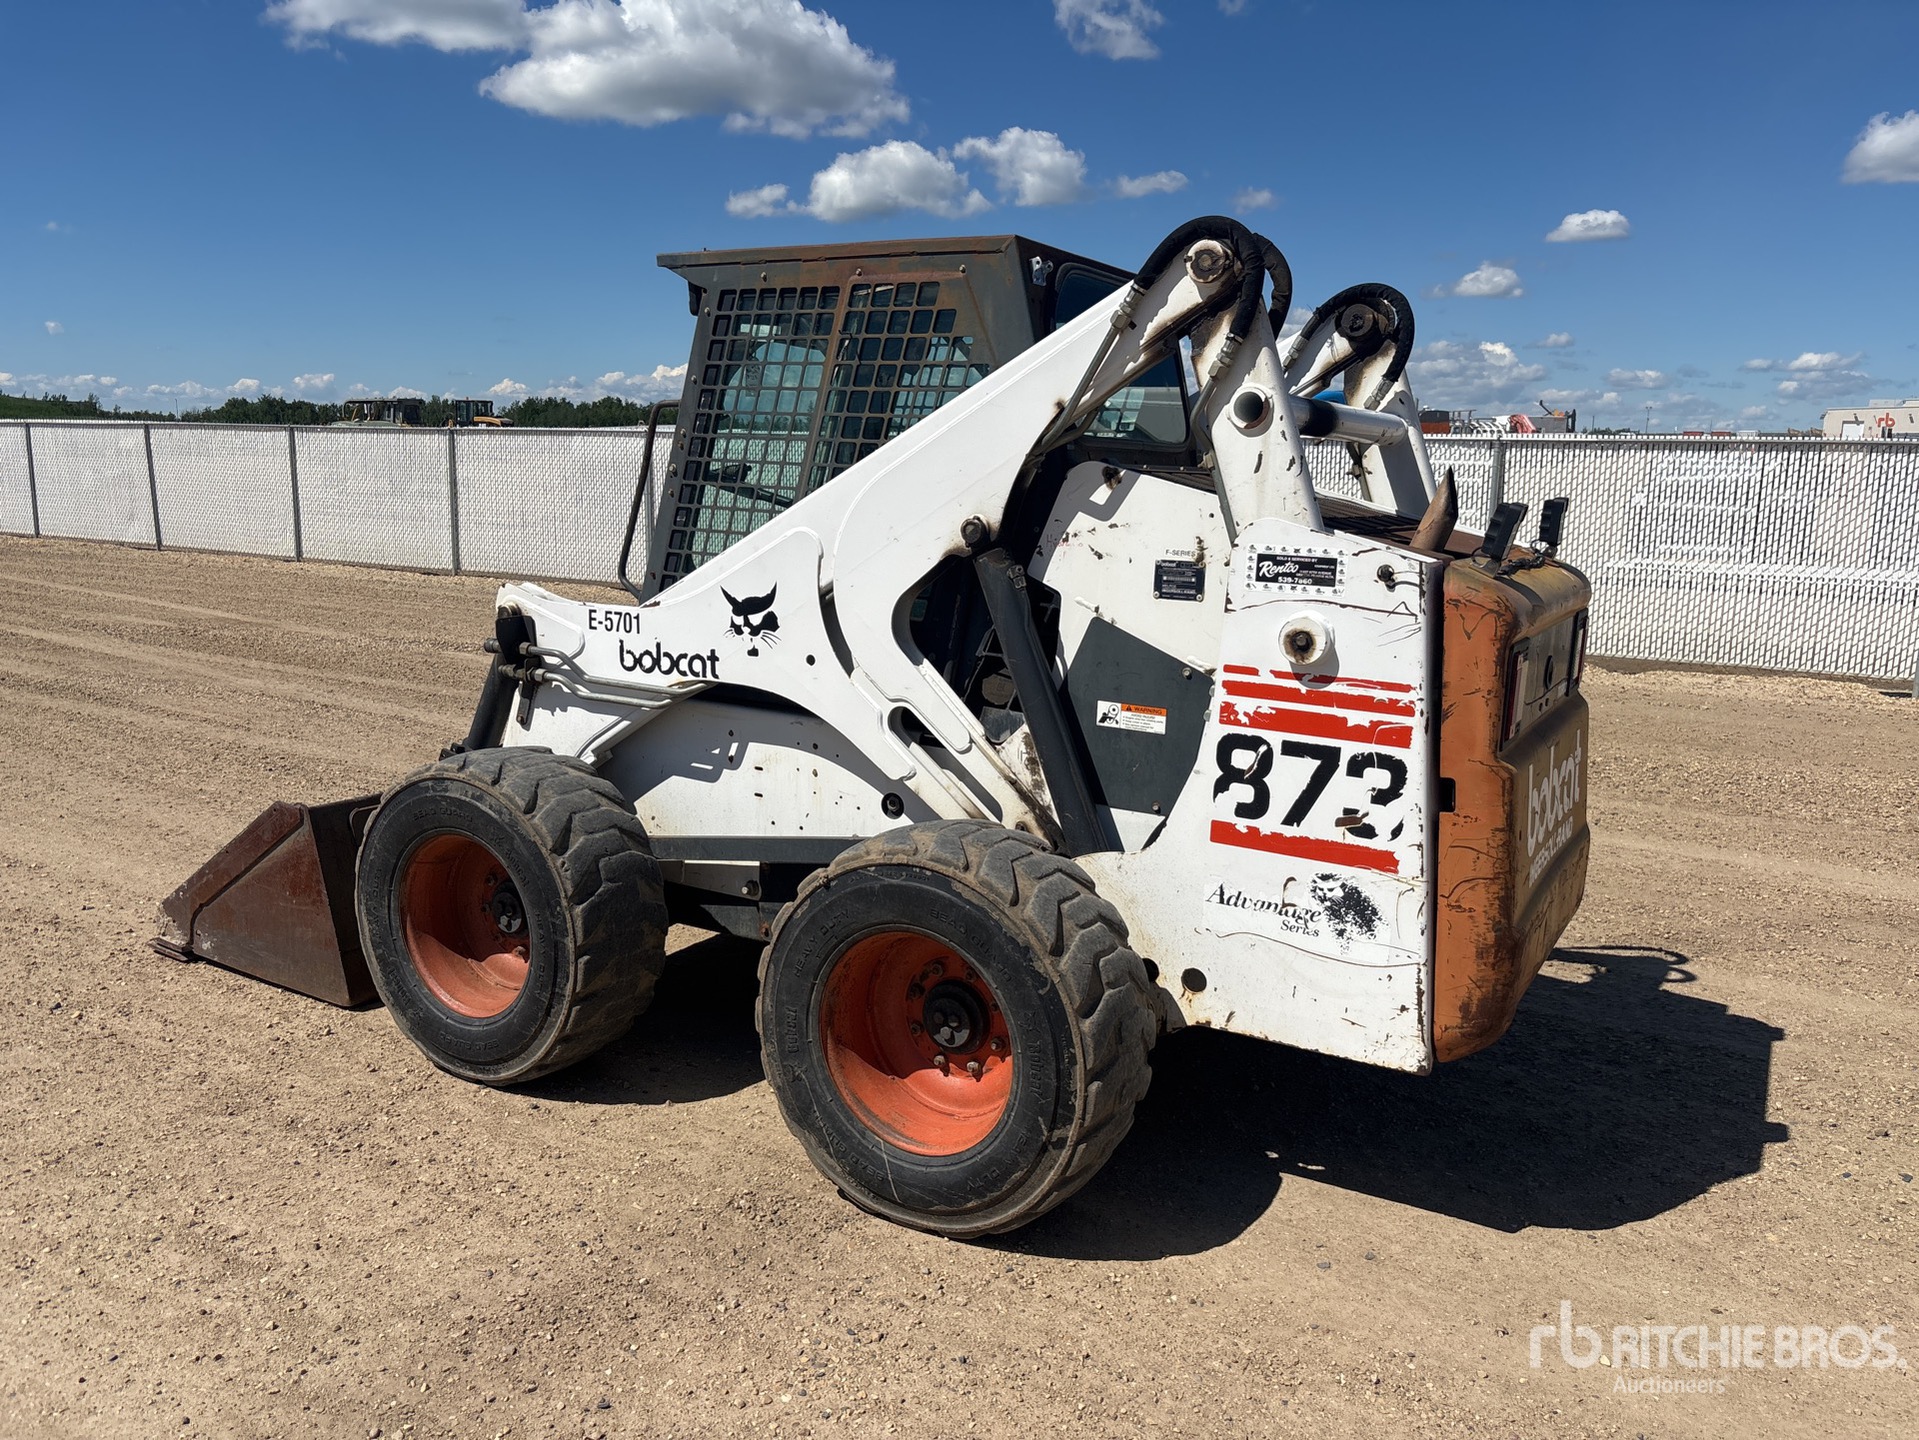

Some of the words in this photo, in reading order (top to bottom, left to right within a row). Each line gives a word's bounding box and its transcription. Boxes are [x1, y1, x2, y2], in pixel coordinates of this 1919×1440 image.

[1878, 413, 1895, 427] rb
[1166, 549, 1196, 557] F-SERIES
[1259, 561, 1299, 578] Rentco
[588, 609, 641, 635] E-5701
[618, 637, 720, 679] bobcat
[1212, 732, 1408, 842] 873
